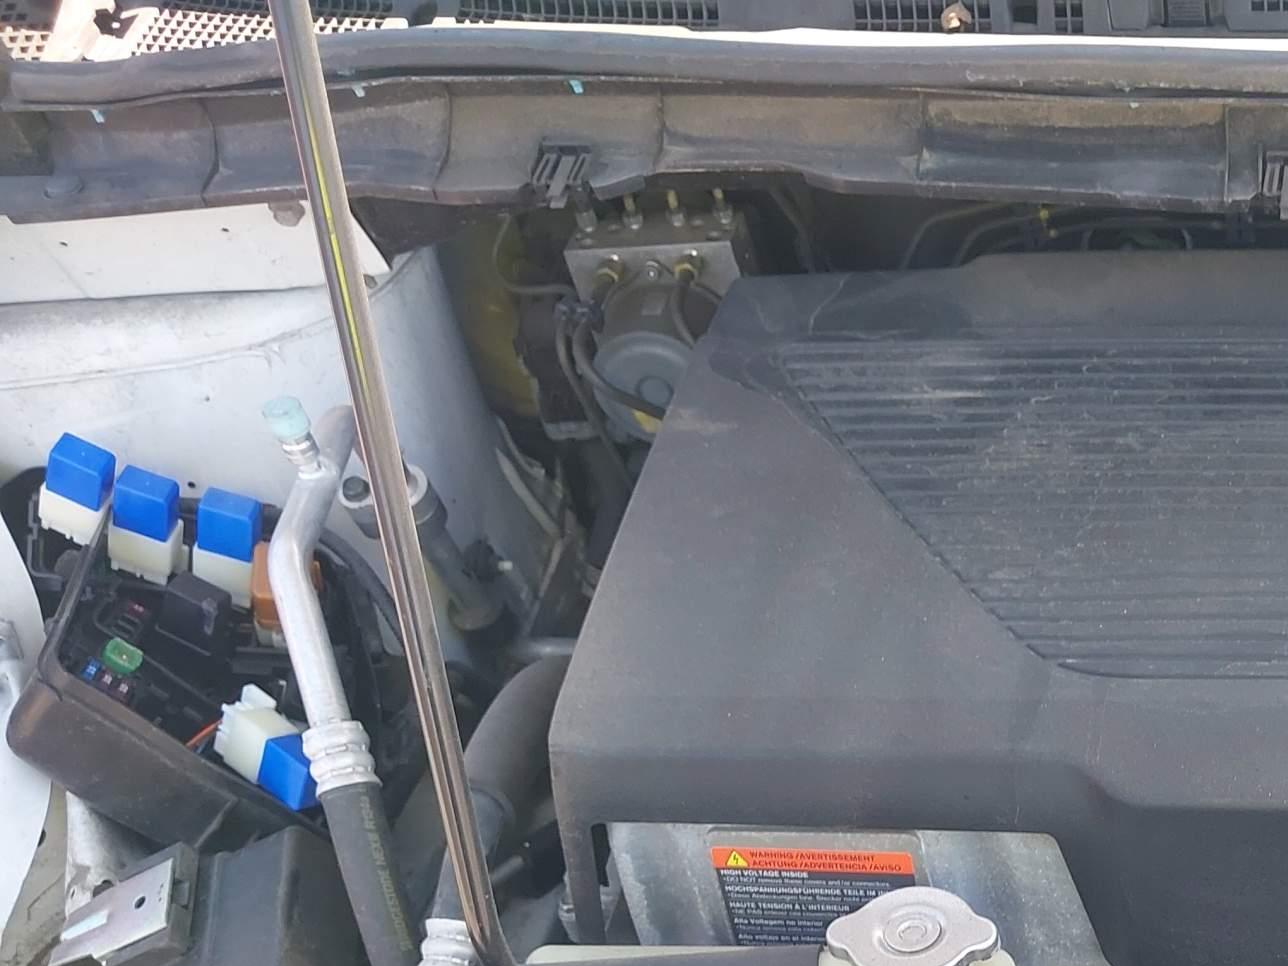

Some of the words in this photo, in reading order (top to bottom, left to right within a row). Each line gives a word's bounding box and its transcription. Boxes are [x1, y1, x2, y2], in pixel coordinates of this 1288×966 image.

[750, 851, 794, 860] WARNING
[752, 859, 797, 868] ACHTUNG
[720, 869, 741, 877] HIGH
[742, 869, 780, 878] VOLTAGE
[781, 871, 809, 879] INSIDE
[729, 901, 756, 909] HAUTE
[758, 902, 793, 910] TENSION
